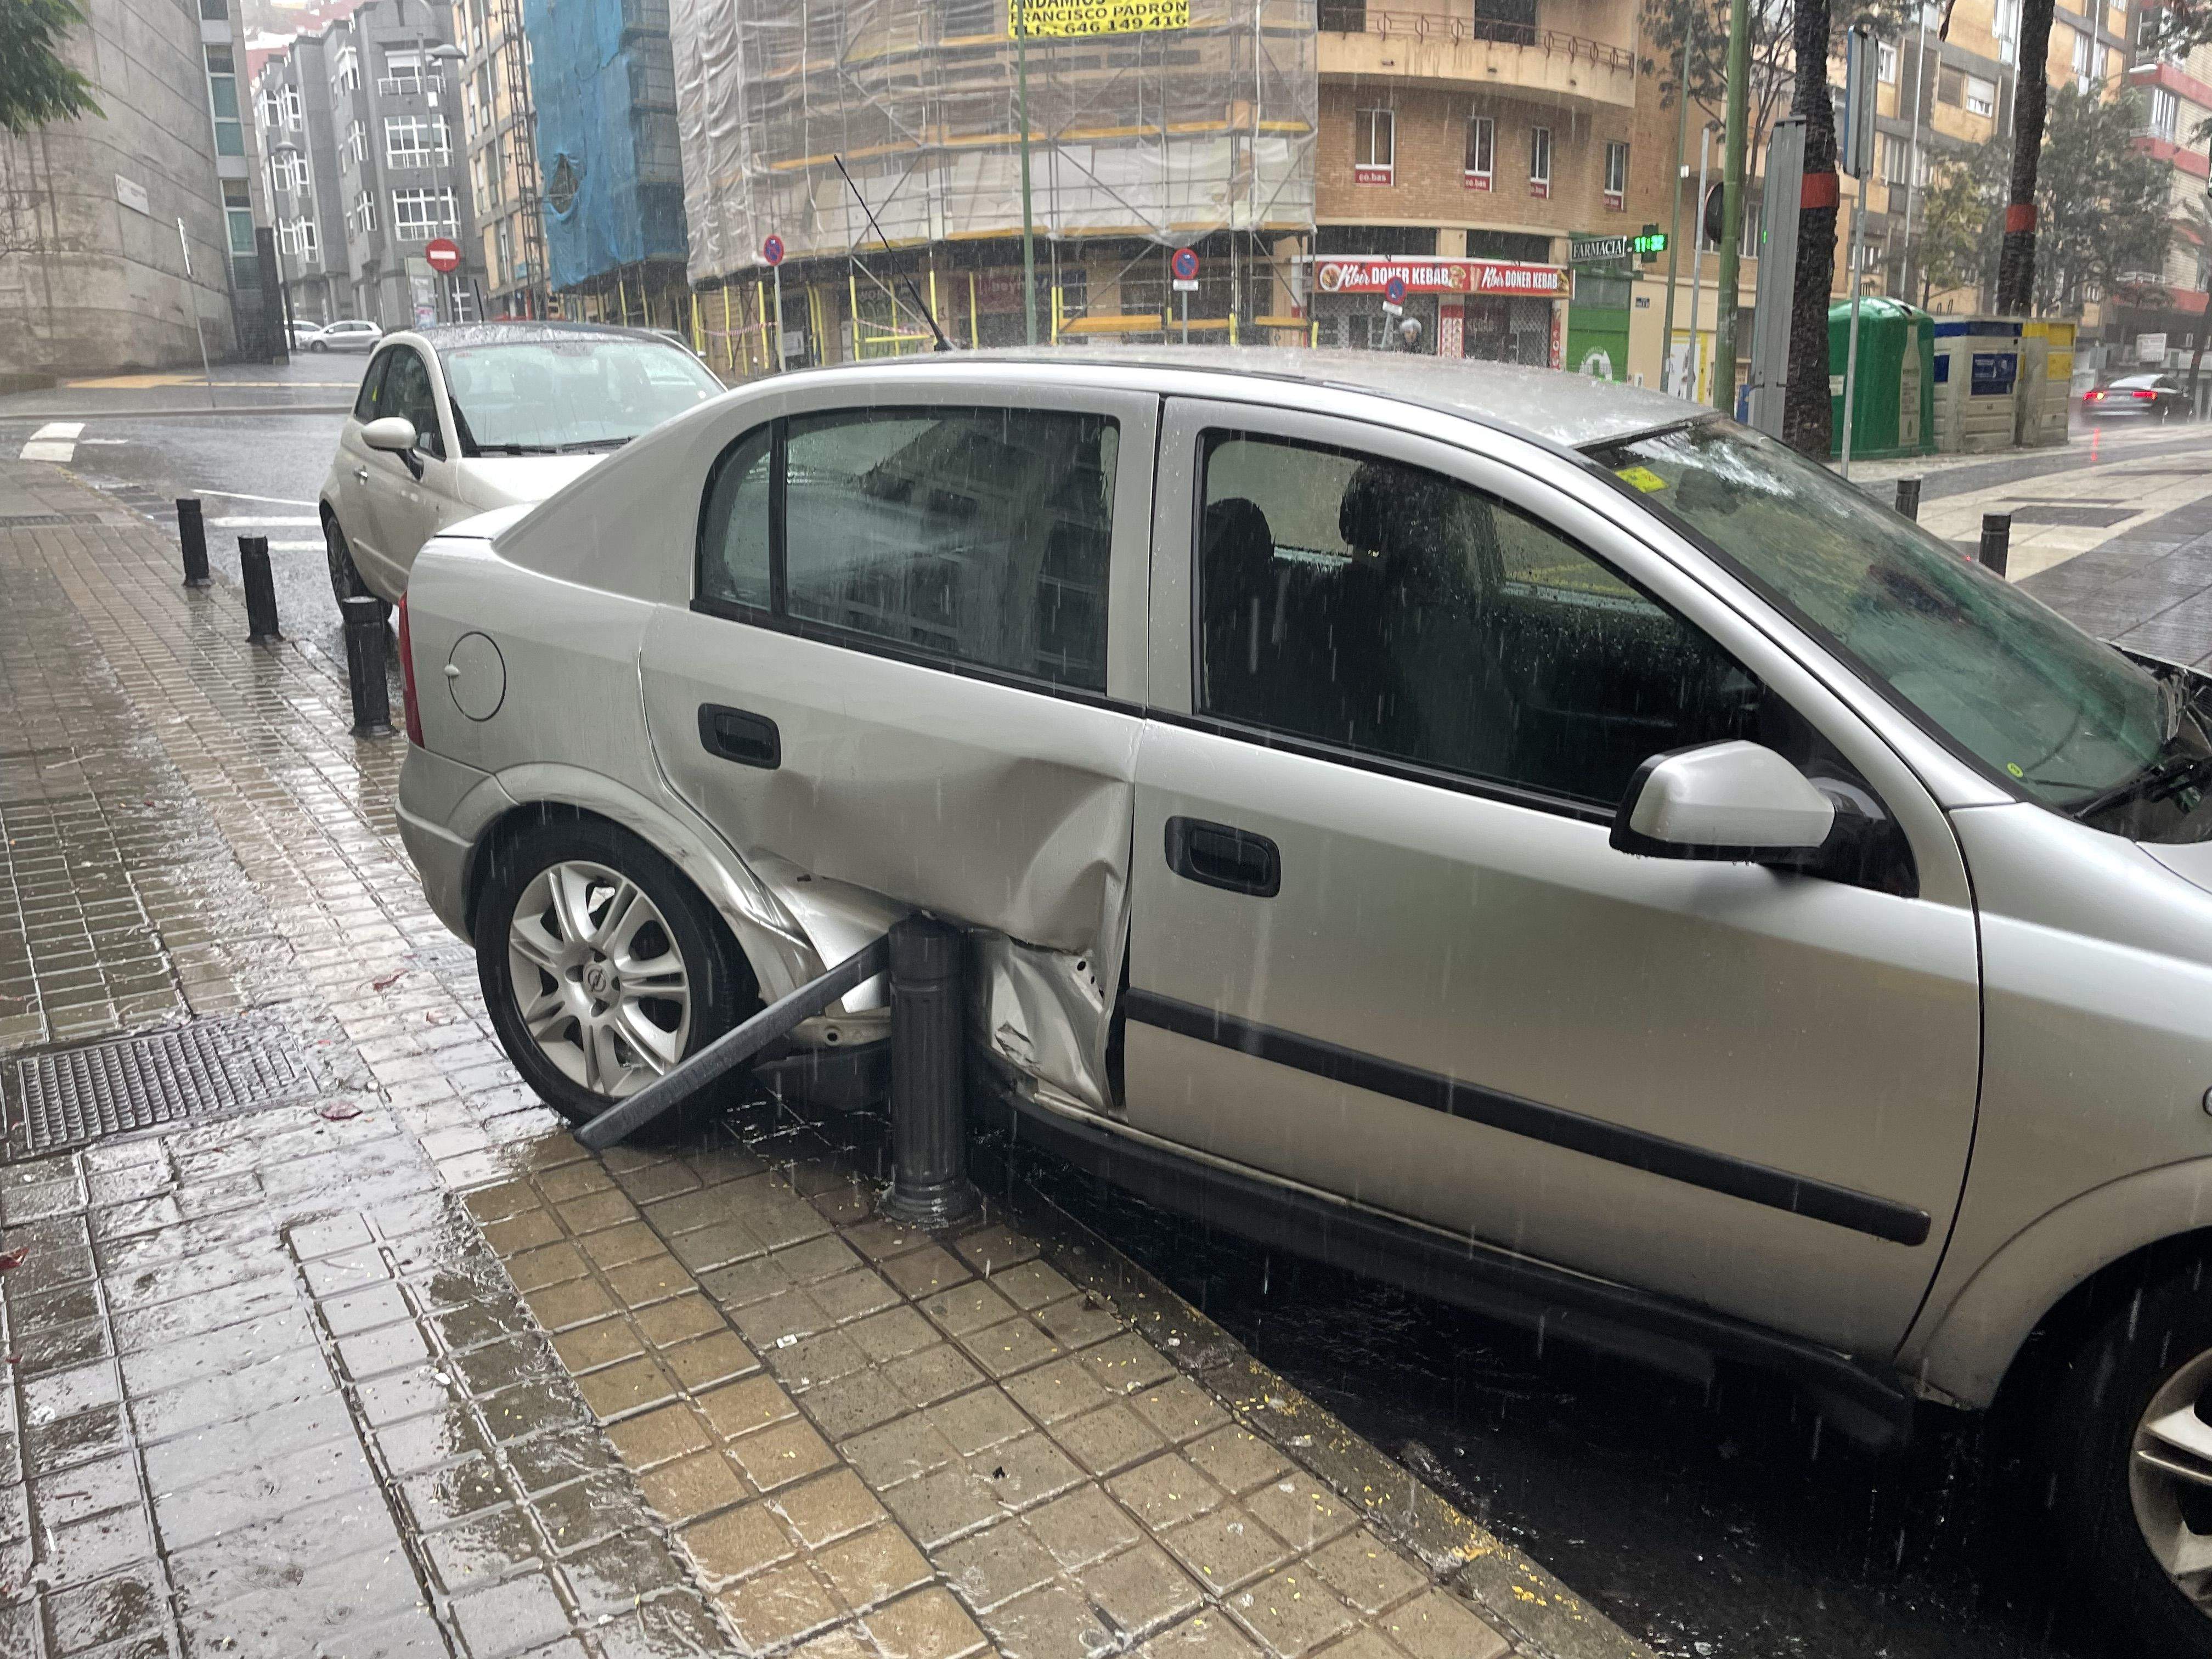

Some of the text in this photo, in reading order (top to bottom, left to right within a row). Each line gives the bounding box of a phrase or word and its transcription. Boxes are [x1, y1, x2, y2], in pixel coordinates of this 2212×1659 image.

[1065, 21, 1100, 34] 646
[1108, 16, 1143, 31] 149
[1149, 14, 1186, 27] 416
[1573, 240, 1622, 258] FARMACIA
[1412, 267, 1449, 285] KEBAB
[1505, 269, 1531, 289] DONER
[1532, 272, 1558, 290] KEBAB
